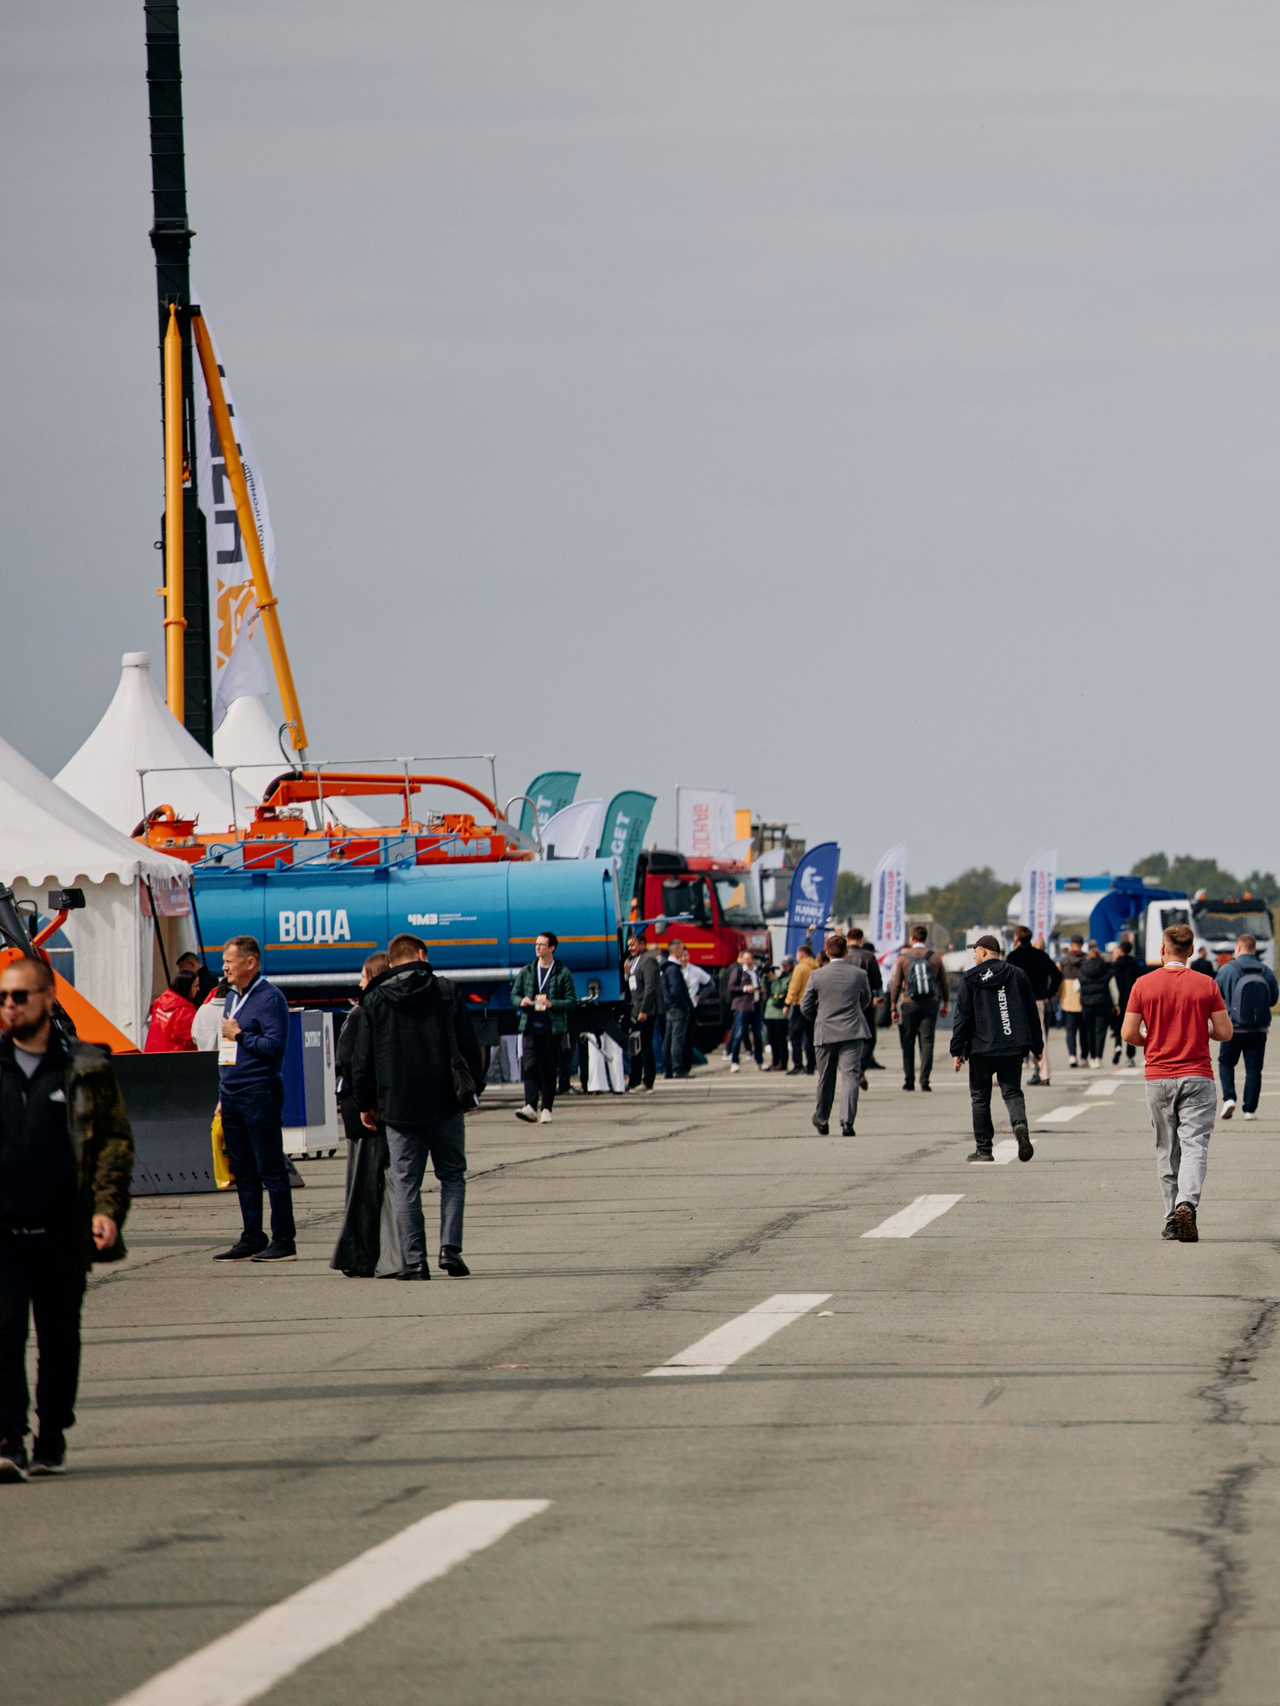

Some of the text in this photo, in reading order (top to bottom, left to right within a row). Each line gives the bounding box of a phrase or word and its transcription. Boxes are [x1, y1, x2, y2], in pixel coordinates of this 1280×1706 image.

[279, 909, 351, 944] ВОДА
[408, 913, 438, 925] ЧМЗ
[997, 990, 1012, 1035] CALVIN KLEIN
